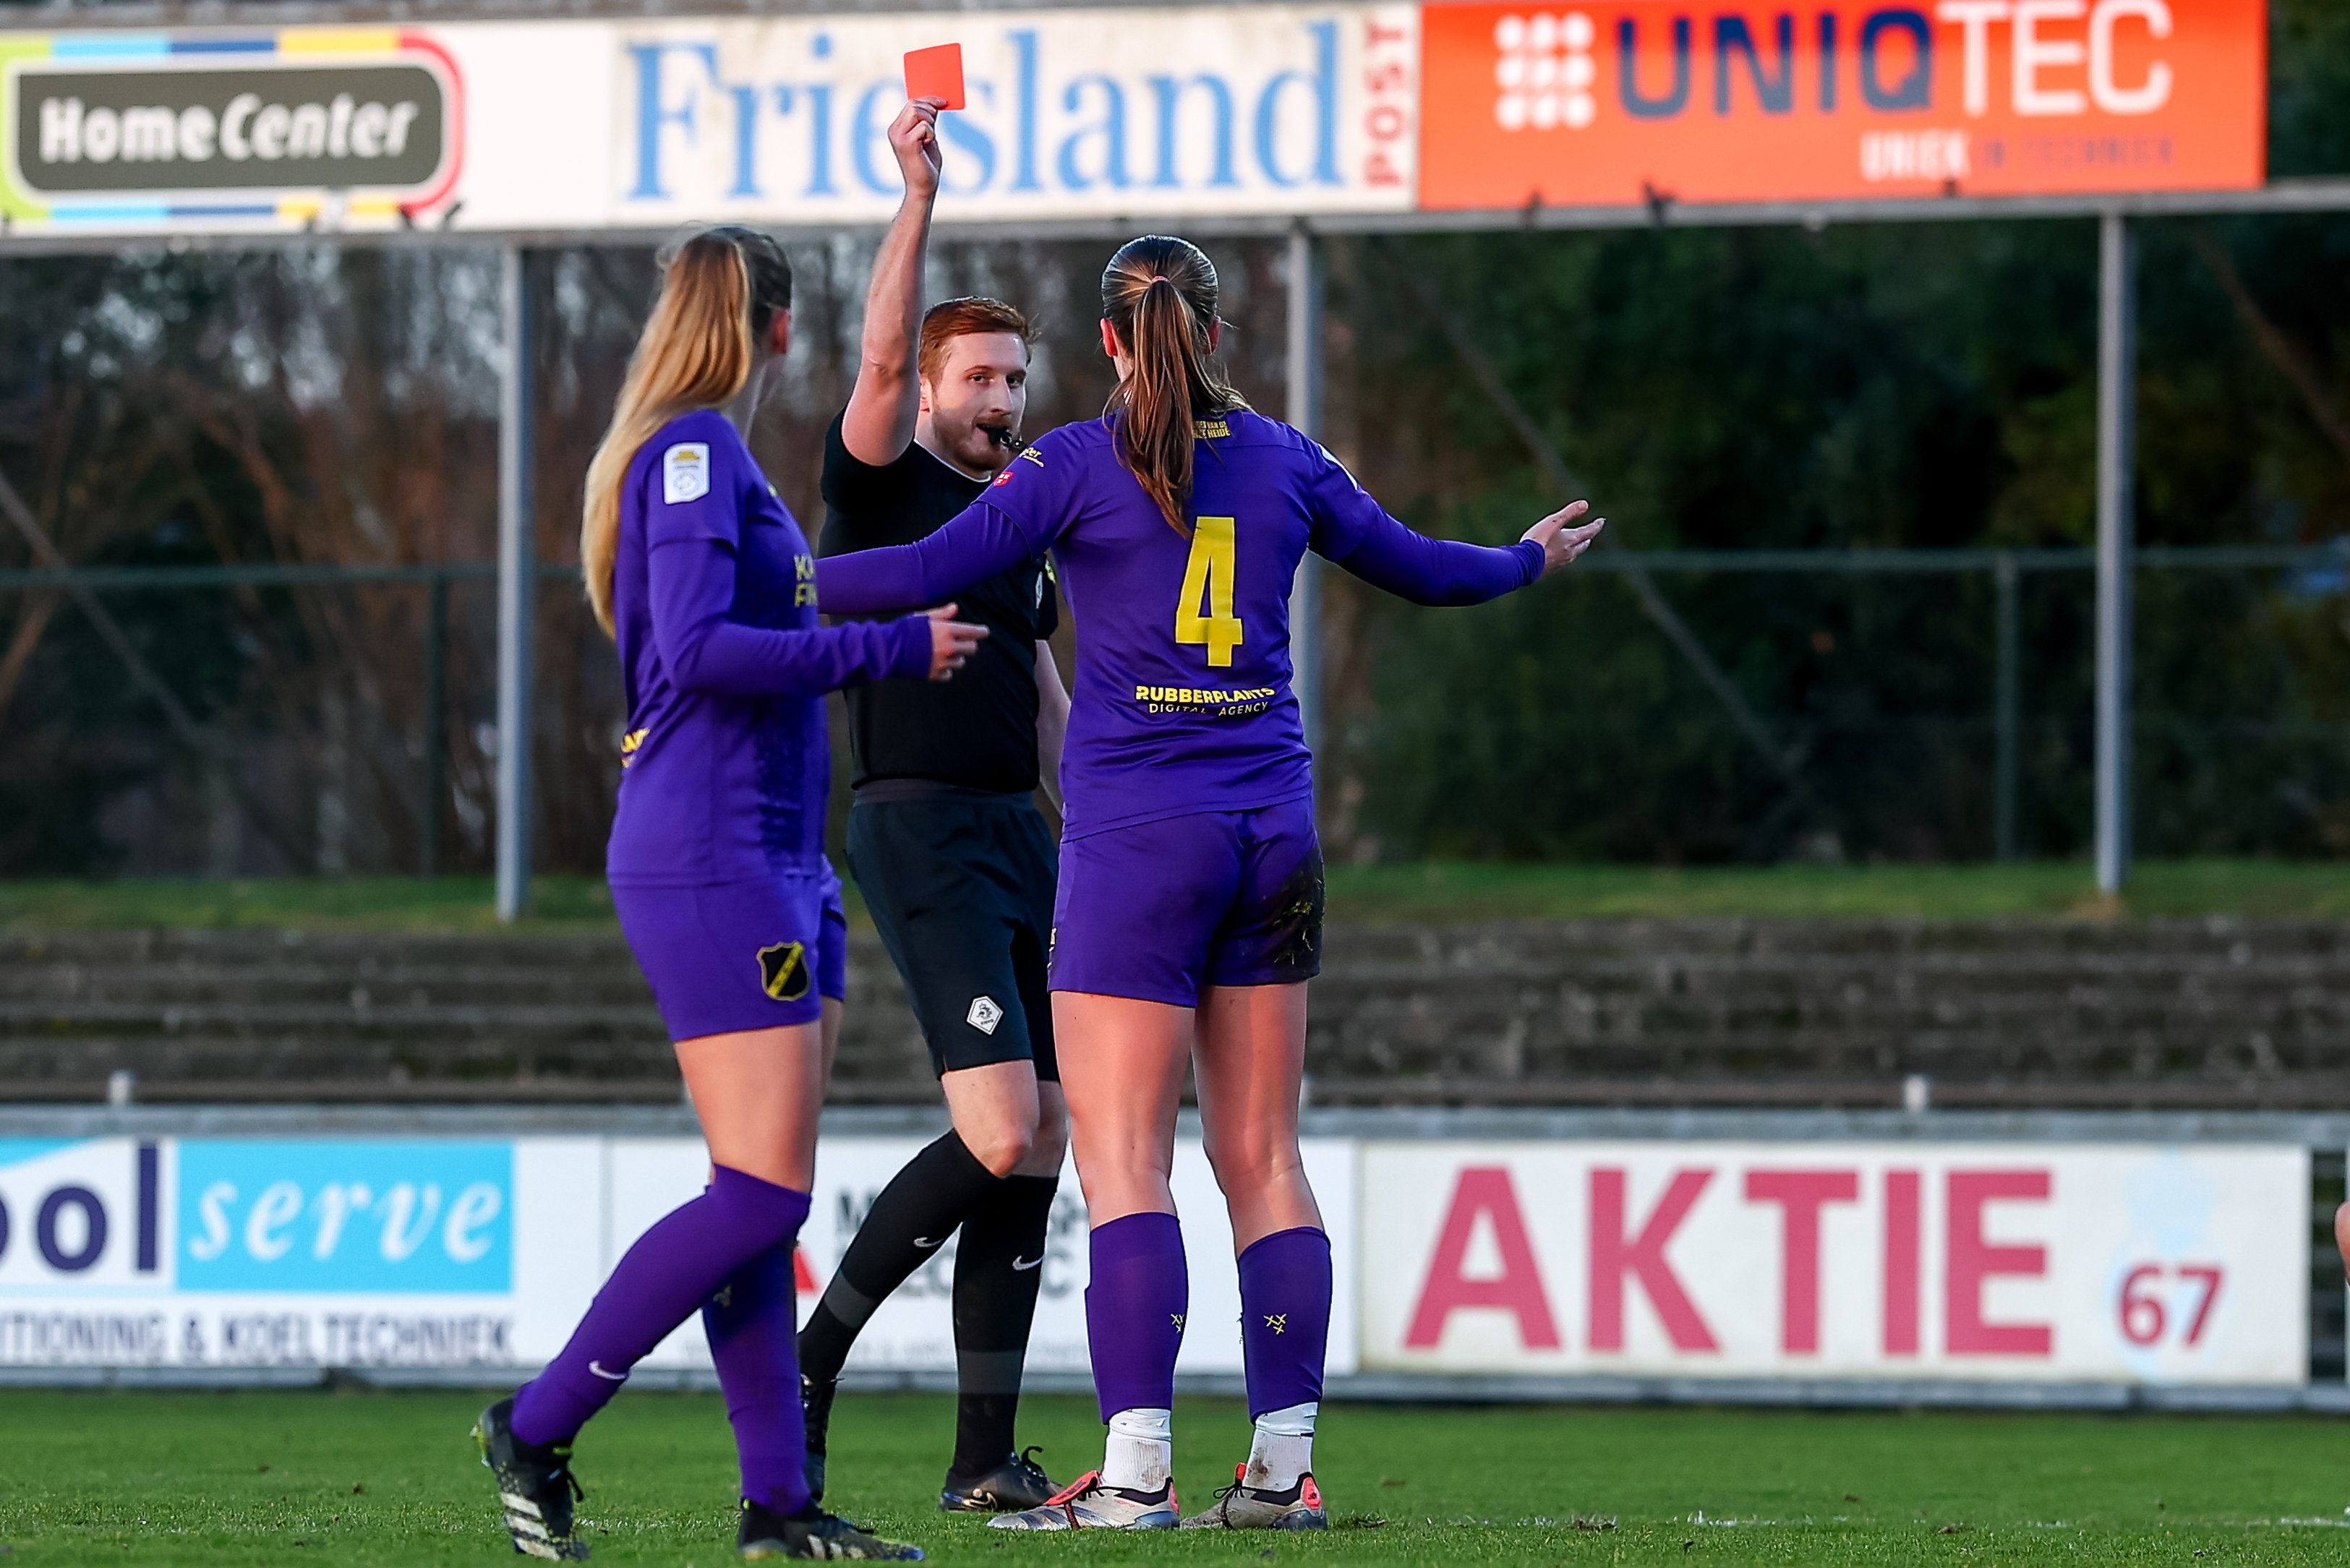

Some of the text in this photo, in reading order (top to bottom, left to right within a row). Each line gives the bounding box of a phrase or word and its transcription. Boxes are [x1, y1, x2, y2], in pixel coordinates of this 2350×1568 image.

[625, 19, 1346, 202] Friesland
[1363, 20, 1405, 188] POST
[1615, 0, 2173, 119] UNIQTEC
[1208, 428, 1231, 438] HEIDE
[1175, 516, 1243, 667] 4
[1135, 685, 1276, 704] RUBBERPLANTS
[1149, 701, 1269, 716] DIGITAL AGENCY
[0, 1141, 505, 1275] ol serve
[1402, 1165, 2226, 1358] AKTIE 67
[178, 1311, 208, 1365] &
